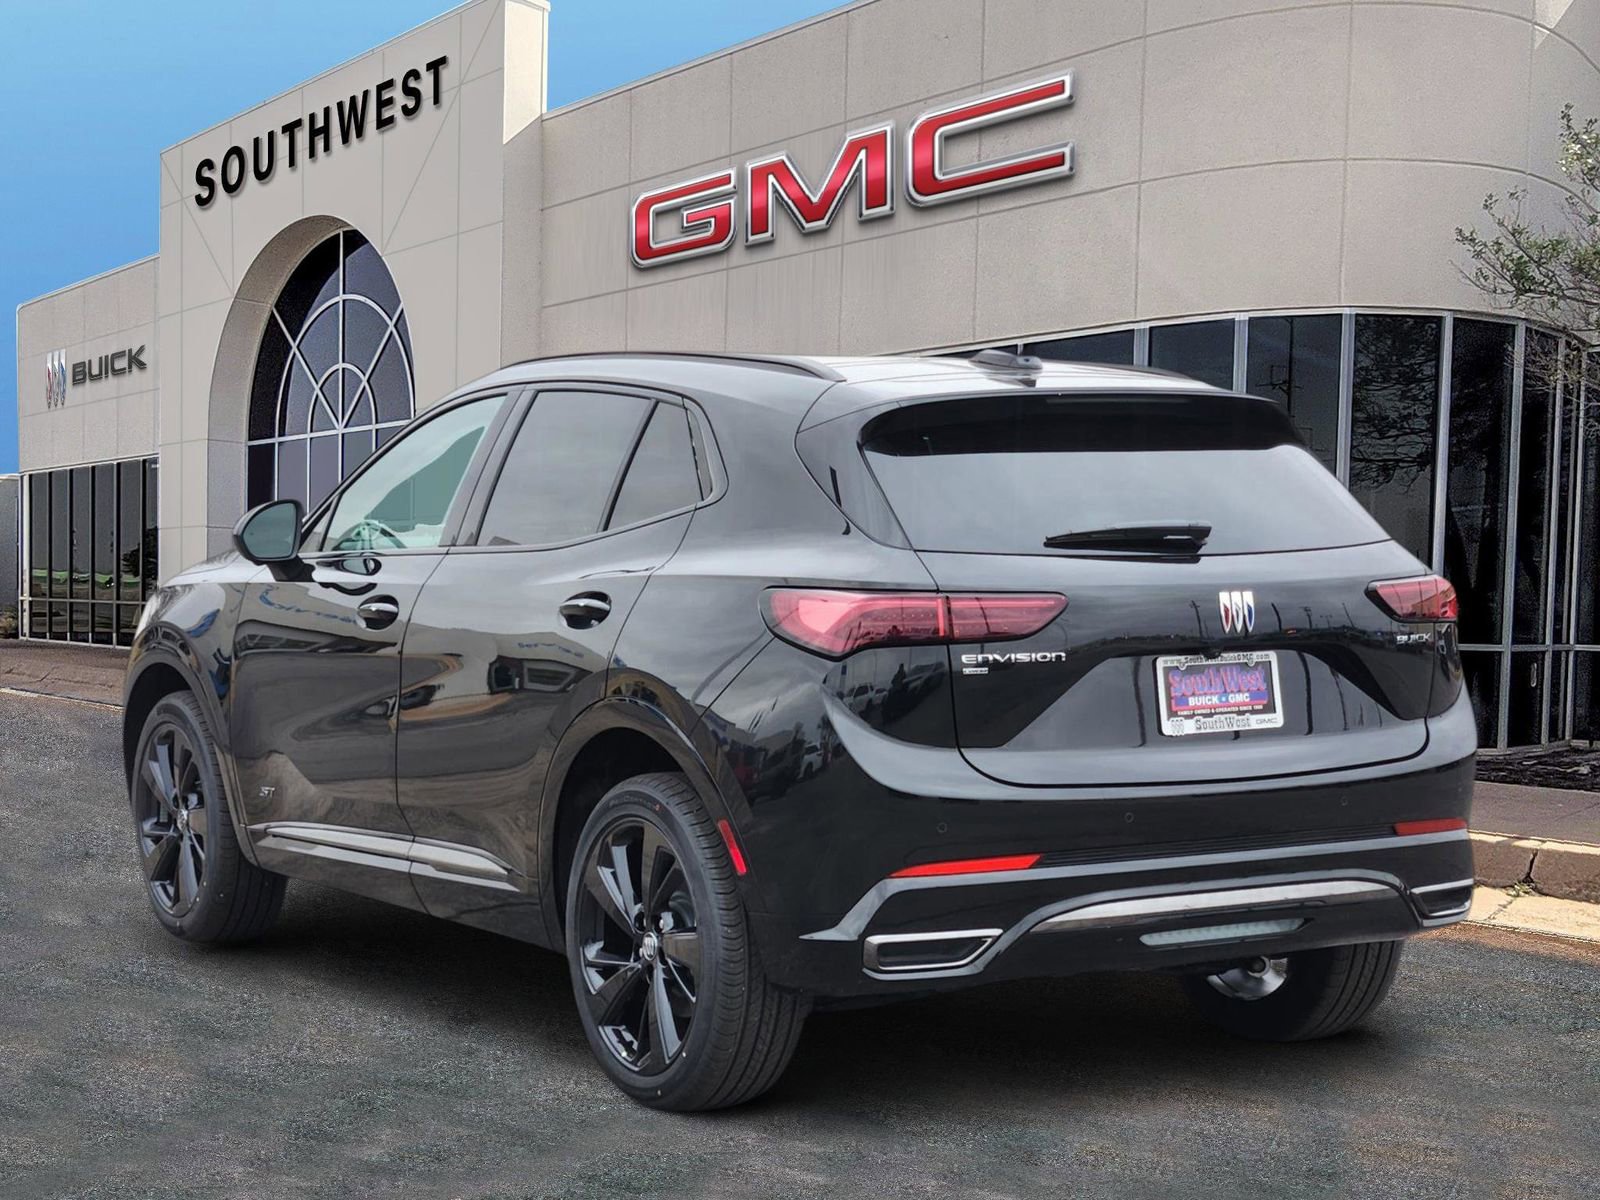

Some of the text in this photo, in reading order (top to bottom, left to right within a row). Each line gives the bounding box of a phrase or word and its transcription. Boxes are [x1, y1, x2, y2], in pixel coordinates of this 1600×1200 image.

[194, 55, 448, 207] SOUTHWEST
[631, 69, 1075, 268] GMC
[72, 344, 147, 386] BUICK
[1396, 632, 1431, 645] BUICK
[1188, 692, 1250, 706] BUICK GMC
